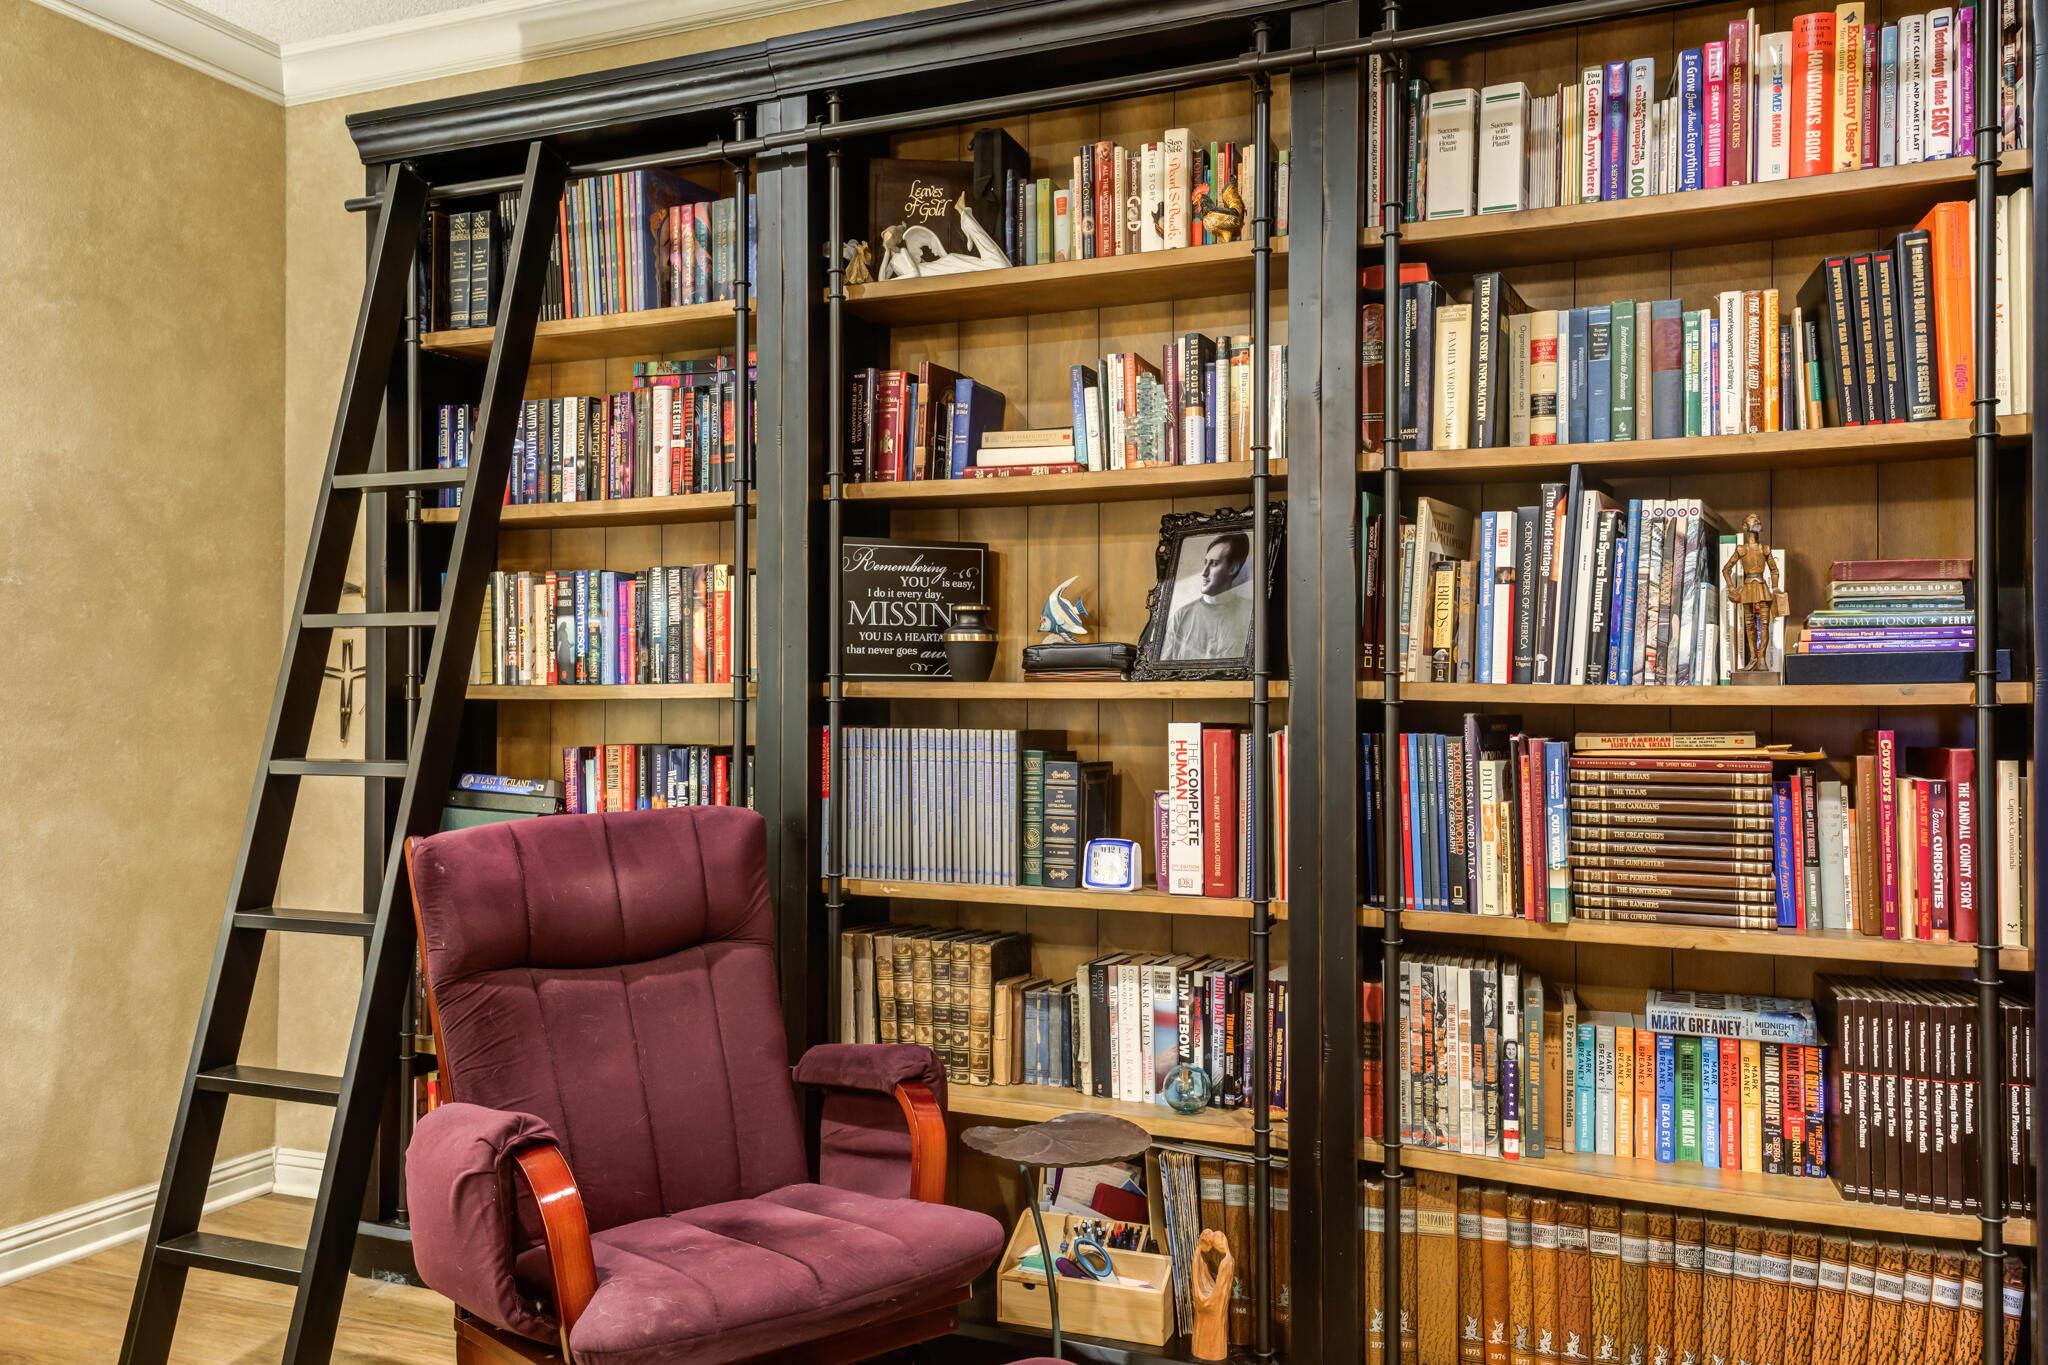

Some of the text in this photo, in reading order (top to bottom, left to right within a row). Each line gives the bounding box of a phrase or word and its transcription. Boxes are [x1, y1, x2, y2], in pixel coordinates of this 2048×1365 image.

[1687, 67, 1697, 92] Grow
[1733, 67, 1741, 95] SECRET
[1844, 25, 1860, 119] Extraordinary
[1931, 28, 1950, 137] Technology Made EASY
[1805, 50, 1823, 162] HANDYMAN'S BOOK
[1491, 121, 1513, 129] Success
[1492, 133, 1510, 141] House
[1587, 88, 1598, 194] Garden Anywhere
[1632, 85, 1642, 166] Gardening Secrets
[1709, 85, 1720, 168] SMART SOLUTIONS
[1732, 123, 1740, 148] CURES
[1772, 114, 1781, 147] REMEDIES
[1684, 133, 1698, 186] Everything
[908, 179, 944, 199] Leaves
[904, 199, 952, 224] of Gold
[1190, 339, 1199, 367] BIBLE
[1478, 278, 1490, 421] THE BOOK OF INSIDE INFORMATION
[1749, 297, 1759, 389] THE MANAGERIAL GRID
[1190, 367, 1199, 394] CODE
[1620, 372, 1629, 400] Business
[526, 404, 537, 470] DAVID BALDACCI
[1498, 529, 1508, 547] LIFE
[1541, 490, 1556, 577] The World Heritage
[843, 547, 948, 584] Remembering
[900, 576, 976, 590] YOU is easy,
[1593, 521, 1611, 633] The Sports Immortals
[868, 587, 944, 601] I do it every day.
[1520, 521, 1532, 650] SCENIC WONDERS OF AMERICA
[576, 575, 585, 657] JAMES PATTERSON
[848, 600, 958, 627] MISSIN
[1436, 585, 1449, 628] BIRDS
[1828, 616, 1973, 626] ON MY HONOR PERRY
[846, 644, 865, 655] that
[868, 647, 894, 655] never
[896, 647, 917, 657] goes
[859, 632, 943, 642] YOU IS A HEARTA
[499, 777, 531, 787] VIGILANT
[1465, 753, 1474, 813] UNIVERSAL
[1483, 768, 1493, 802] DUTY
[1880, 740, 1892, 802] COWBOYS
[1175, 740, 1189, 846] HUMAN BODY
[1187, 741, 1199, 846] THE COMPLETE
[1552, 814, 1561, 870] OUR WORLD
[1958, 782, 1973, 910] THE RANDALL COUNTY STORY
[1468, 850, 1476, 880] ATLAS
[1933, 836, 1944, 909] CURIOSITIES
[1178, 974, 1190, 1058] TIM TEBOW
[1214, 976, 1225, 1027] JOHN DALY
[1566, 1015, 1574, 1028] Up
[1651, 1015, 1742, 1036] MARK GREANEY
[1754, 1021, 1797, 1030] MIDNIGHT
[1761, 1029, 1790, 1038] BLACK
[1566, 1030, 1574, 1059] Front
[1566, 1070, 1574, 1086] Bill
[1619, 1098, 1629, 1144] BALLISTIC
[1661, 1103, 1670, 1148] DEAD EYE
[1792, 1126, 1801, 1163] BURNER
[1491, 1353, 1506, 1361] 1976
